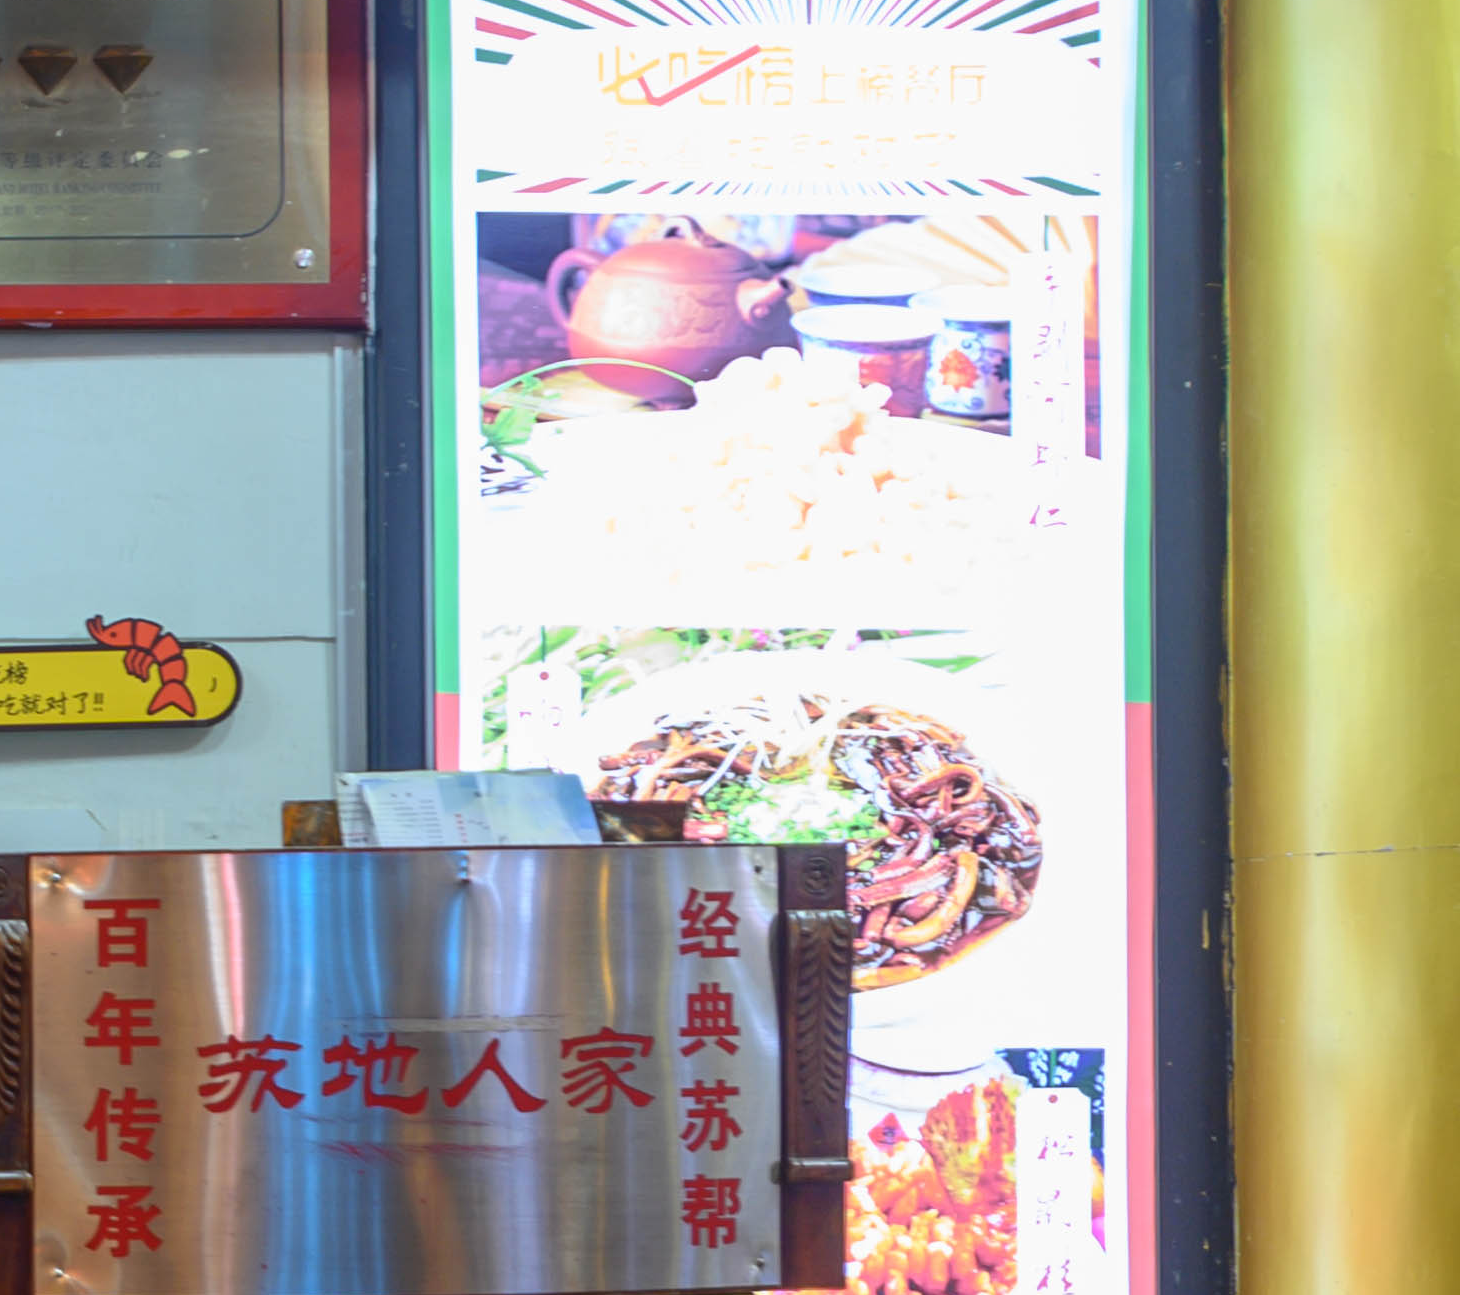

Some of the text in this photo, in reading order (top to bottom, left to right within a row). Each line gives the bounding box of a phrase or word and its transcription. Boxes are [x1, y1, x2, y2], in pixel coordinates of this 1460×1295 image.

[83, 899, 163, 1258] 百年传承
[197, 1026, 655, 1115] 苏地人家
[679, 887, 741, 1249] 经典苏帮
